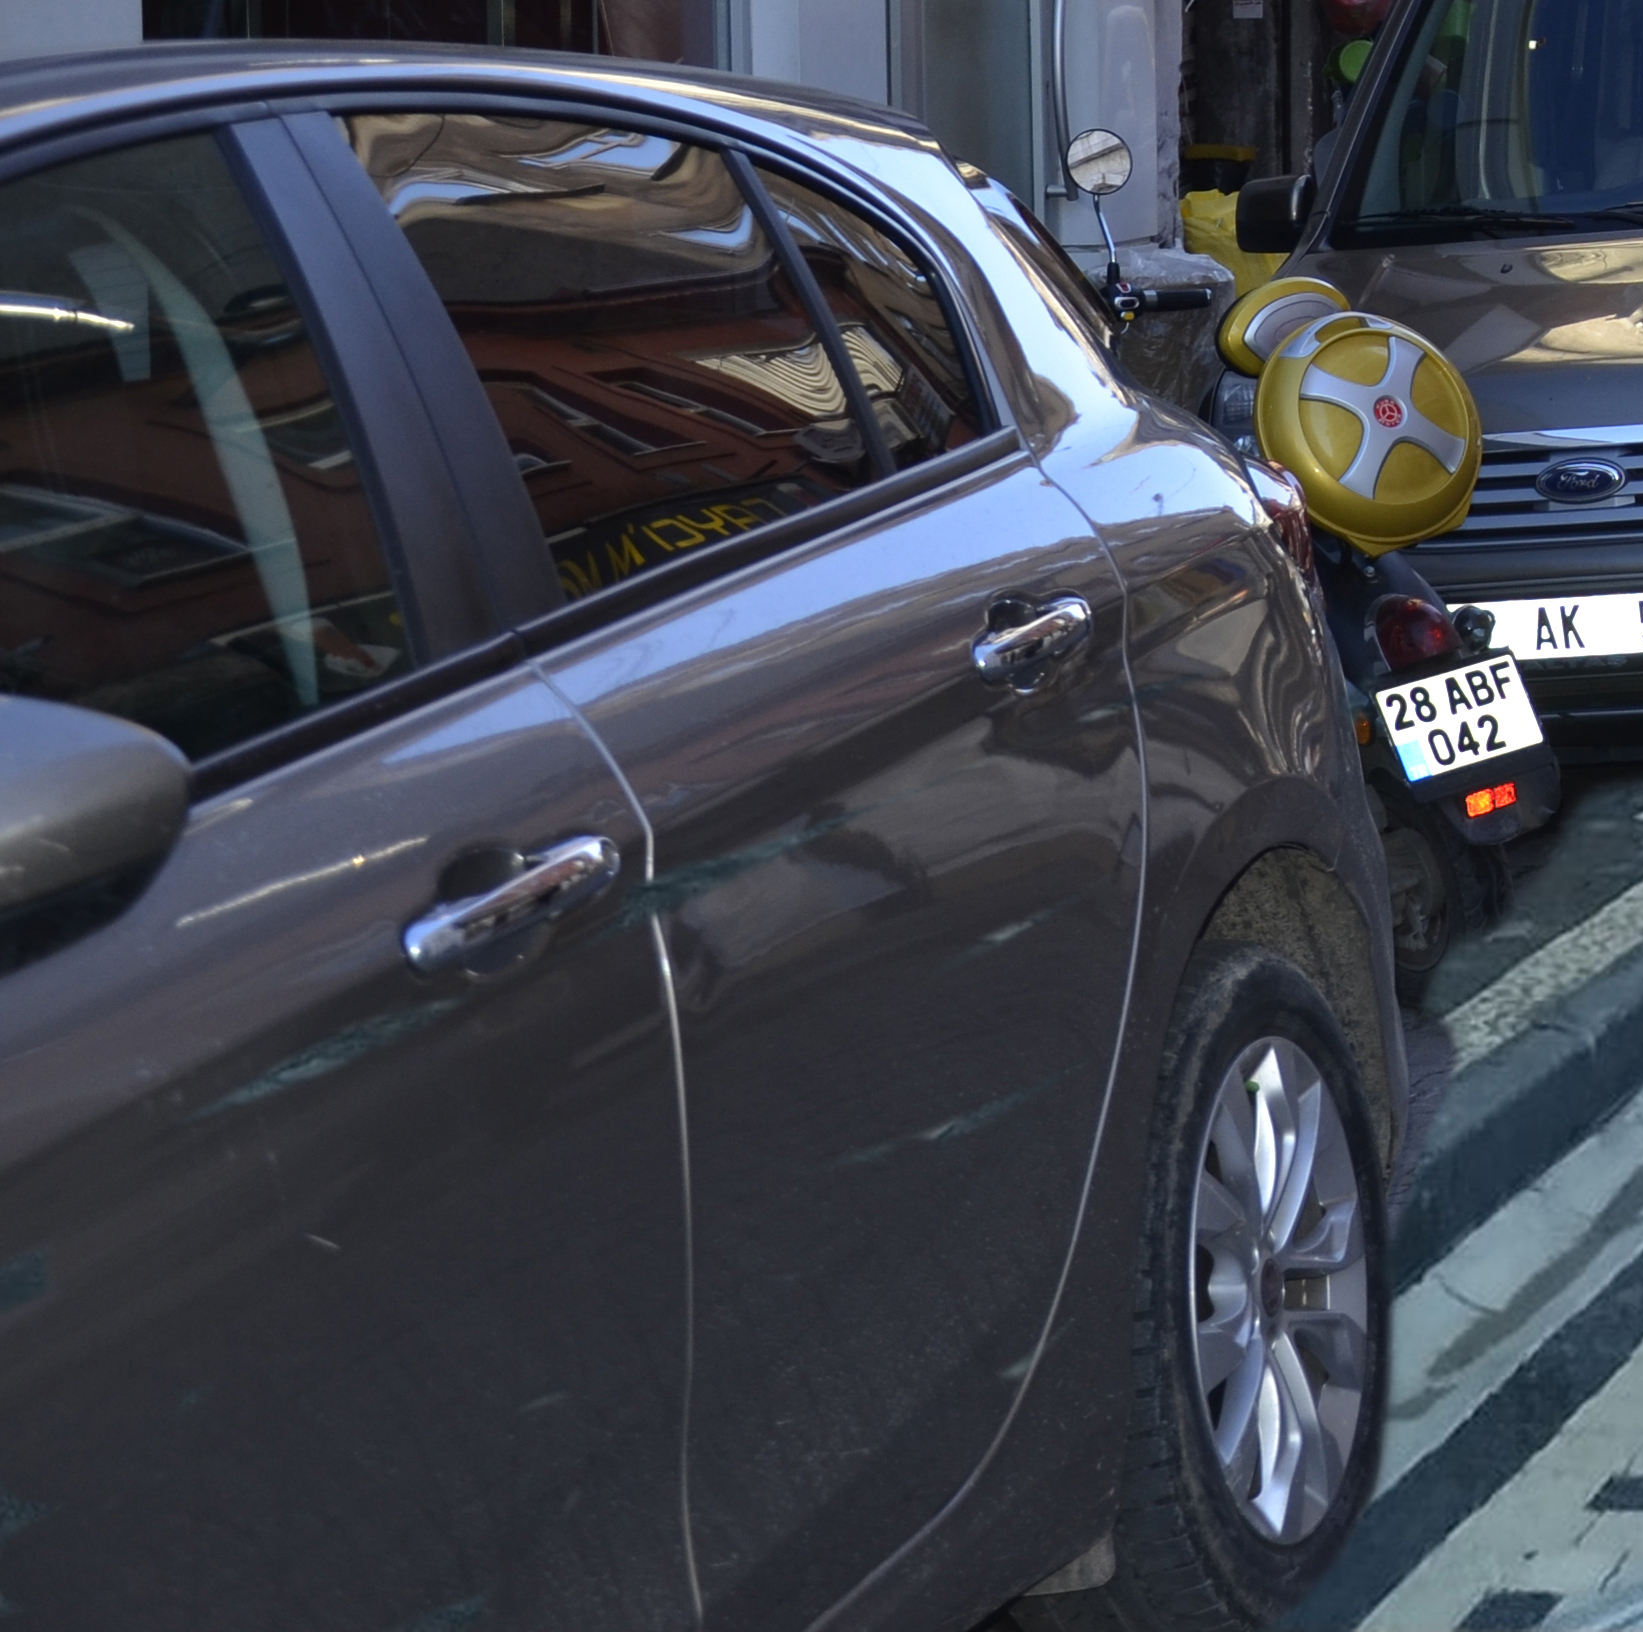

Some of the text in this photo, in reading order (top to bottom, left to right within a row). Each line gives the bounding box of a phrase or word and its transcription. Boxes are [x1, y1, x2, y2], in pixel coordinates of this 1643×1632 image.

[1557, 471, 1600, 489] Ford
[1536, 604, 1585, 650] AK
[1386, 661, 1511, 731] 28 ABF
[1428, 714, 1507, 766] 042
